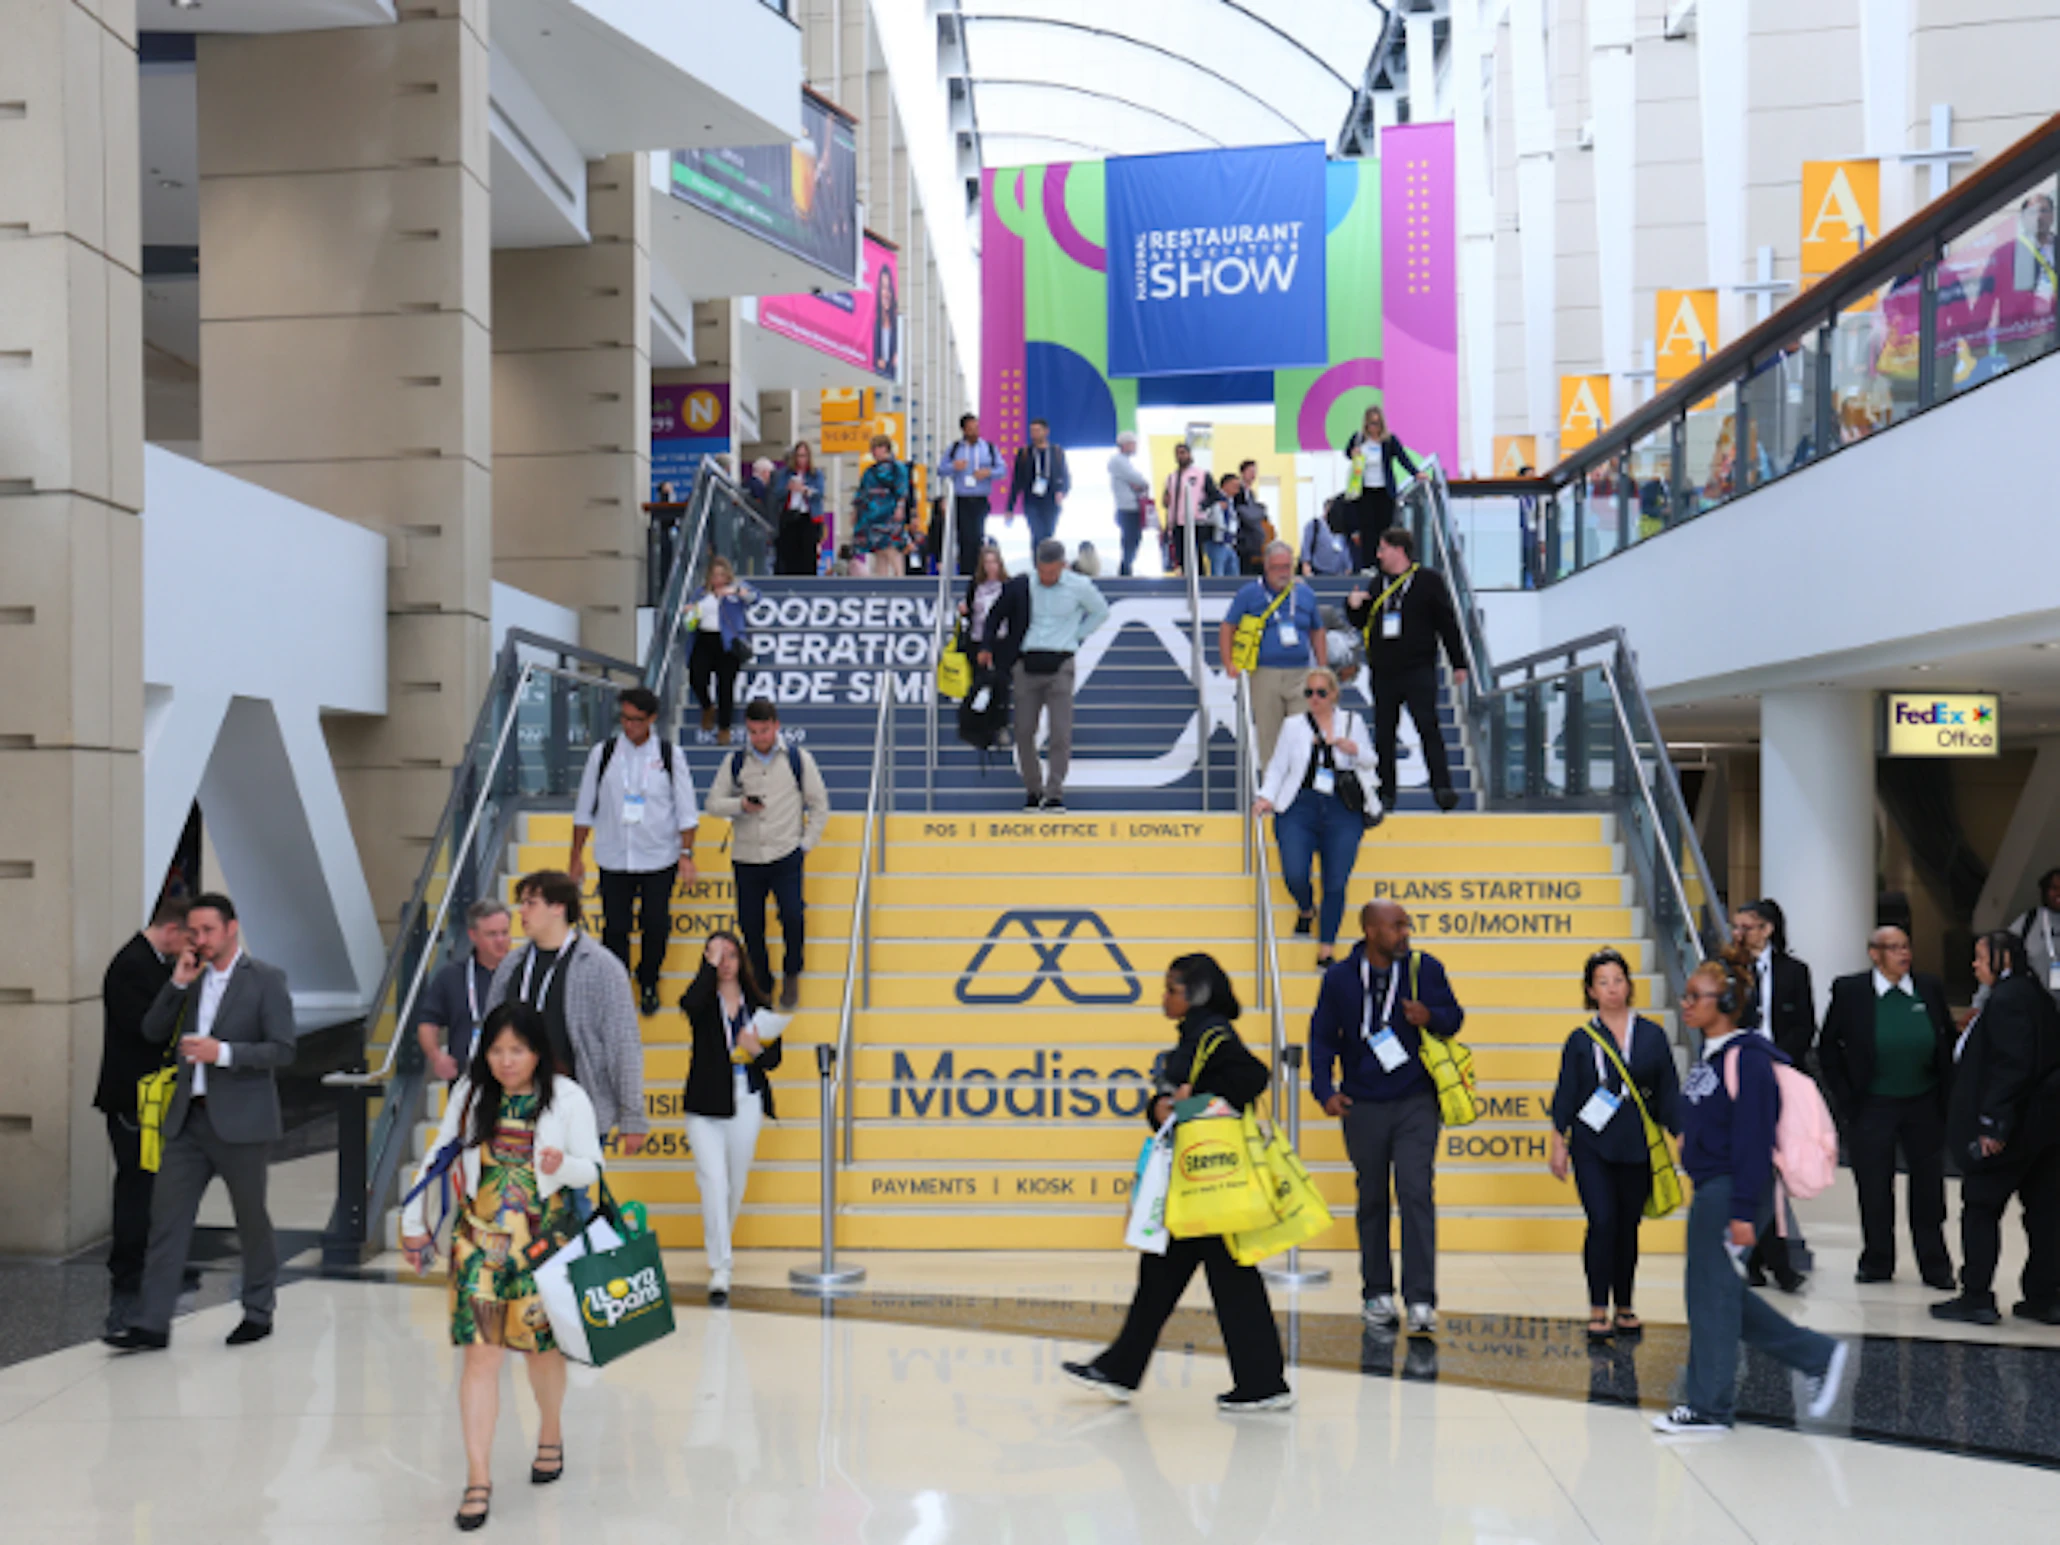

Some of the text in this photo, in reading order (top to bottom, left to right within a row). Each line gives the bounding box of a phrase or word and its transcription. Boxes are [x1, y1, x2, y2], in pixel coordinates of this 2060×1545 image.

[1803, 166, 1876, 242] A
[1150, 221, 1303, 250] RESTAURANT
[1150, 253, 1299, 299] SHOW
[1658, 295, 1716, 355] A
[691, 398, 713, 423] N
[1562, 379, 1608, 430] A
[1896, 703, 1965, 724] FedEx
[1937, 730, 1993, 747] Office
[923, 823, 1205, 839] POS BACK OFFICE LOYALTY
[1374, 881, 1582, 900] PLANS STARTING
[1438, 911, 1572, 936] $0/MONTH
[889, 1050, 1168, 1118] Modisof
[1475, 1096, 1530, 1118] OME
[1447, 1136, 1546, 1157] BOOTH
[871, 1177, 1075, 1195] PAYMENTS KIOSK
